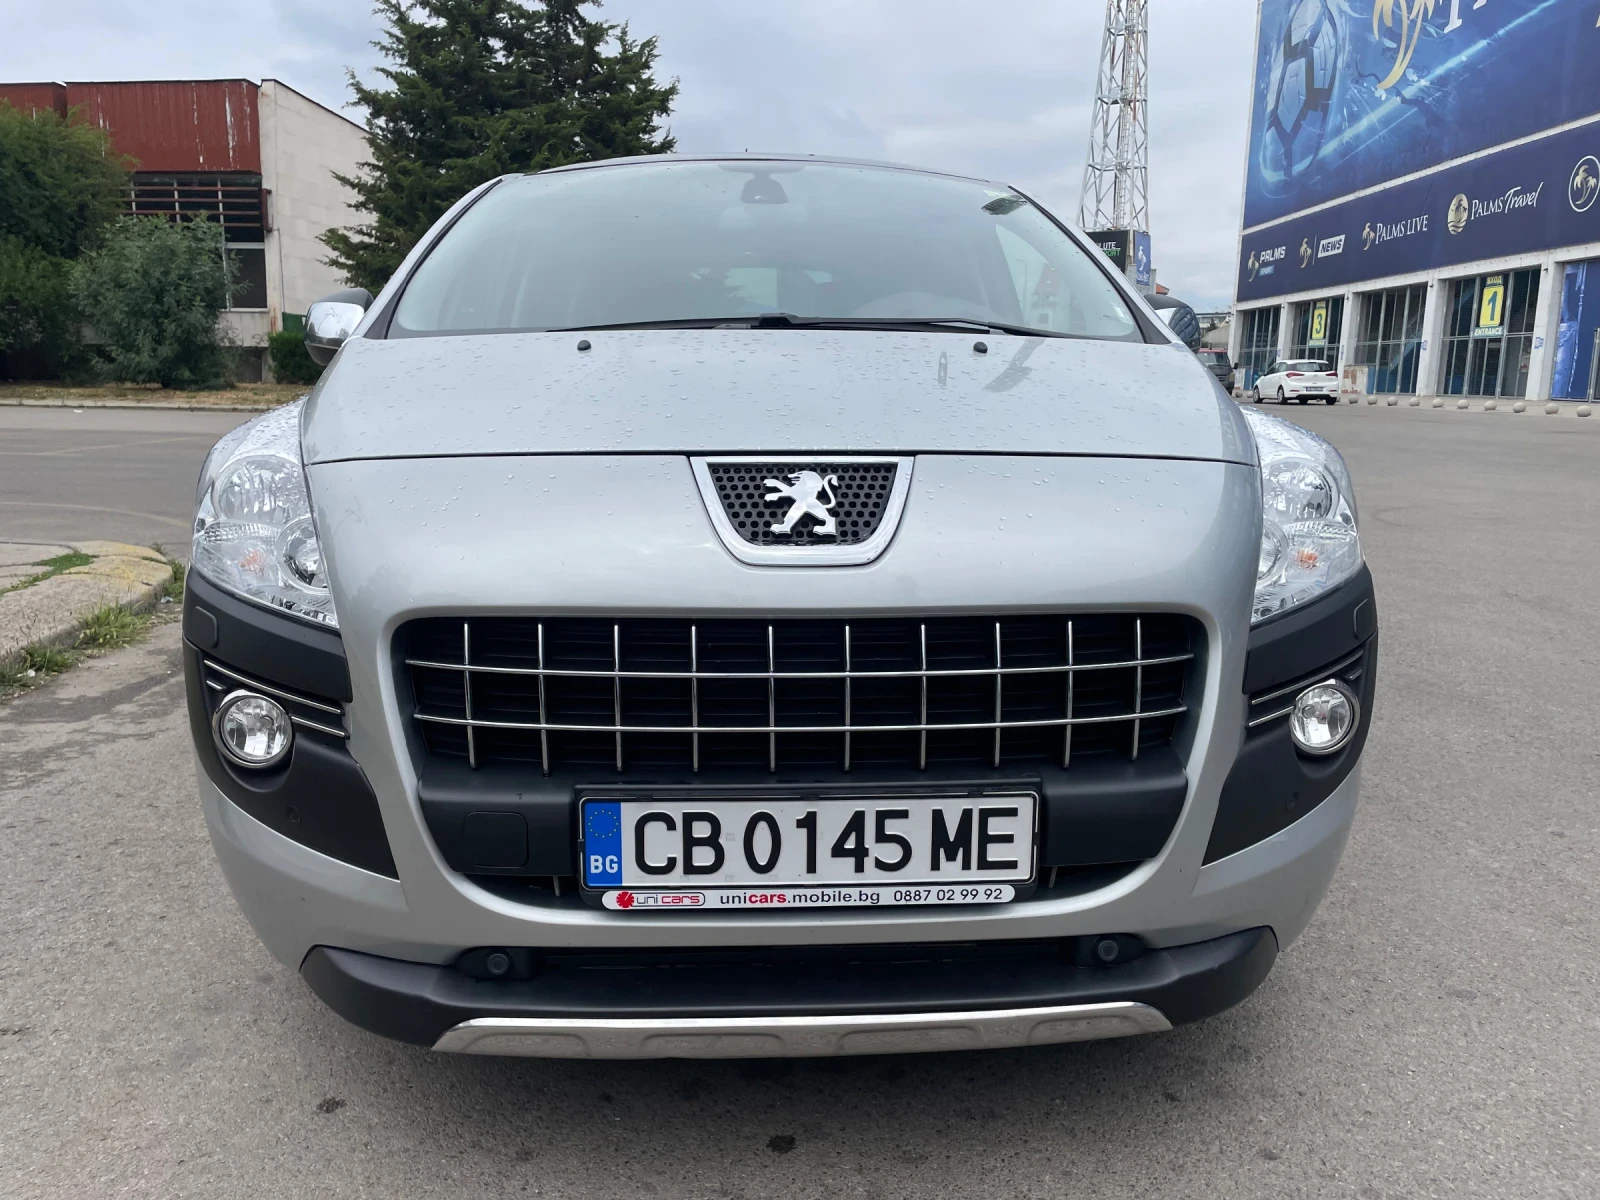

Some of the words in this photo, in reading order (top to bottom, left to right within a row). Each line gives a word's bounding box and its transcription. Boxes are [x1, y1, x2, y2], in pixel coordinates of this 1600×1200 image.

[1470, 196, 1503, 220] PALMS
[1503, 181, 1545, 214] Travel
[1375, 221, 1405, 244] PALMS
[1406, 215, 1429, 236] LIVE
[1260, 246, 1287, 264] PALMS
[1320, 238, 1343, 254] NEWS
[1488, 291, 1498, 321] 1
[1316, 313, 1323, 334] 3
[1474, 327, 1503, 336] ENTRANCE
[633, 810, 726, 876] CB
[743, 808, 913, 875] 0145
[930, 806, 1019, 872] ME
[590, 855, 619, 873] BG
[720, 890, 880, 905] unicars.mobile.bg
[893, 889, 932, 902] 0887
[936, 889, 955, 901] 02
[960, 888, 979, 900] 99
[983, 888, 1002, 900] 92
